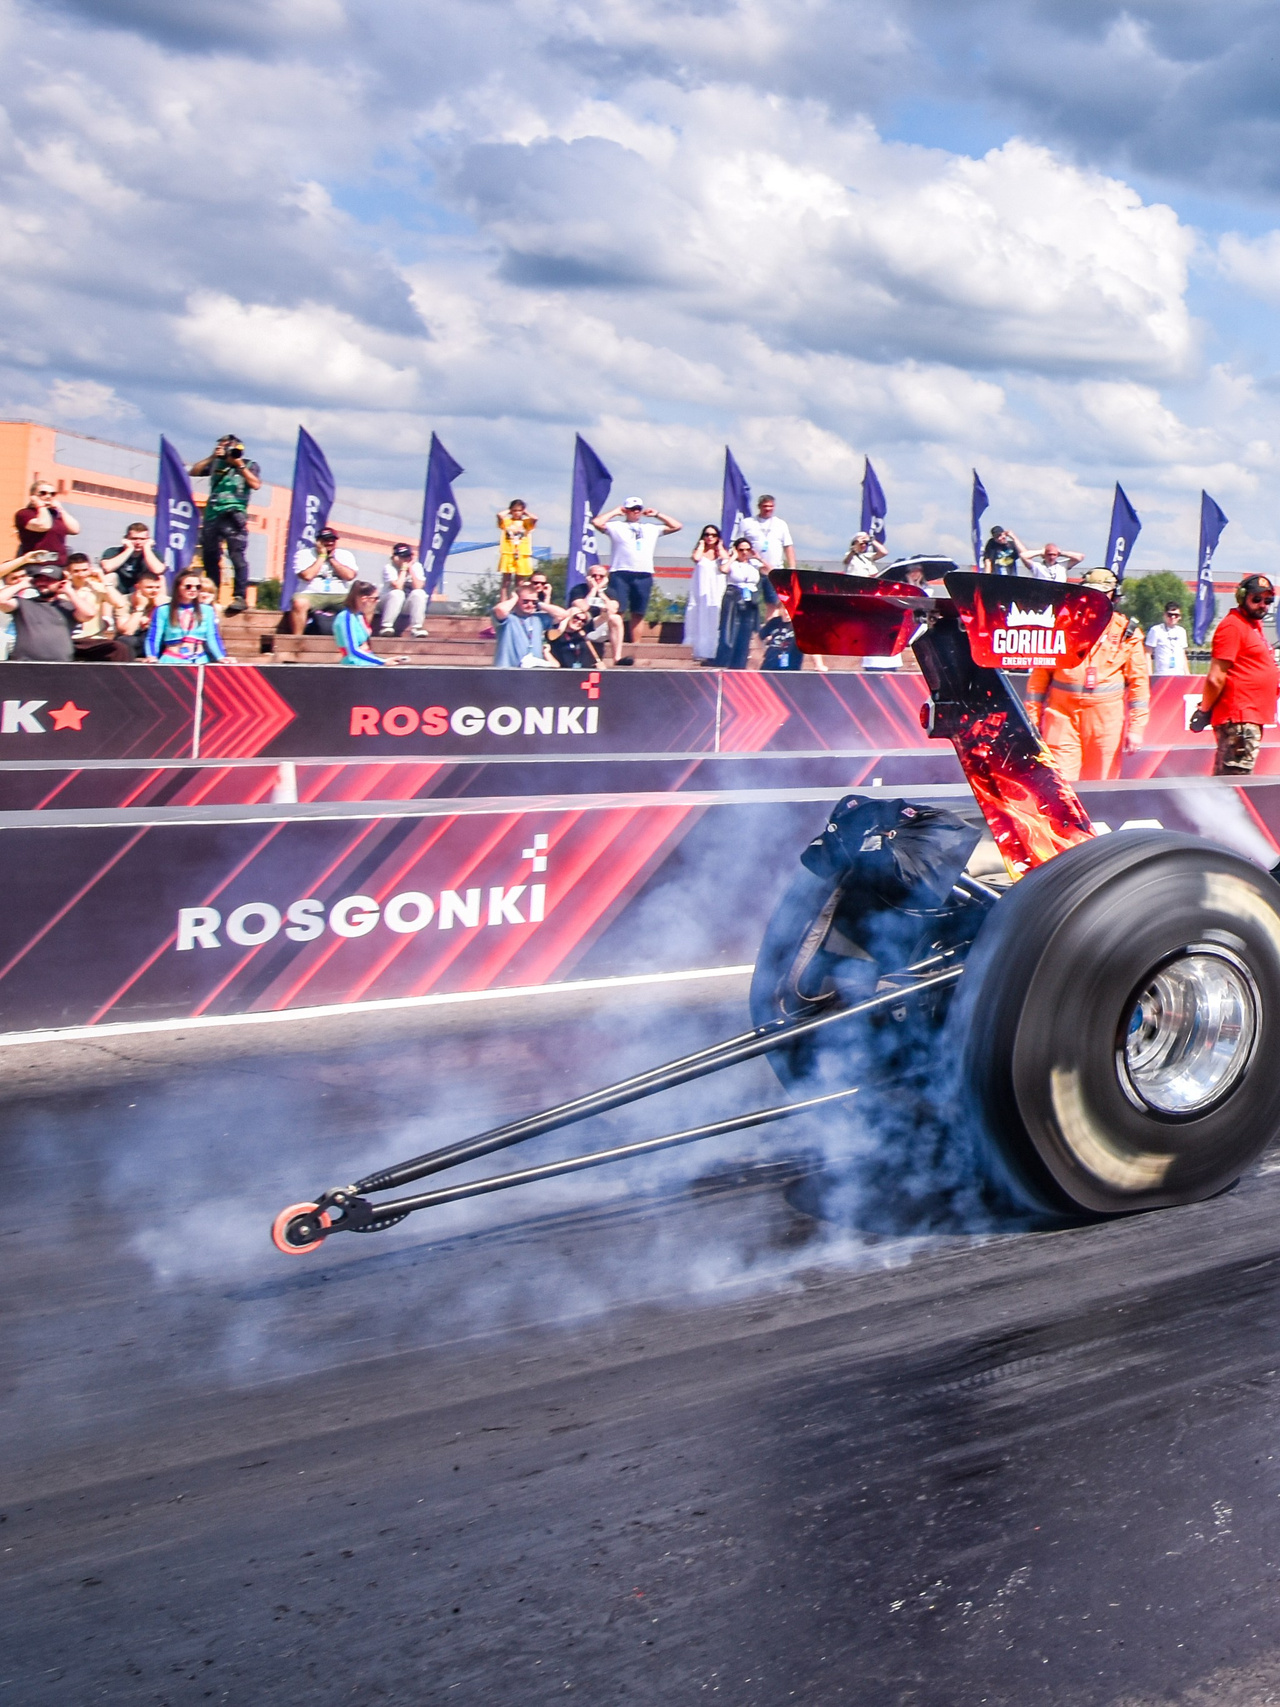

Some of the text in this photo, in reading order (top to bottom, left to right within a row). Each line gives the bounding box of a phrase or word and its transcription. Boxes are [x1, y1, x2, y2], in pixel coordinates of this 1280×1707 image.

[993, 629, 1067, 654] GORILLA
[1002, 656, 1056, 666] ENERGY DRINK
[350, 706, 599, 736] ROSGONKI
[176, 884, 546, 951] ROSGONKI
